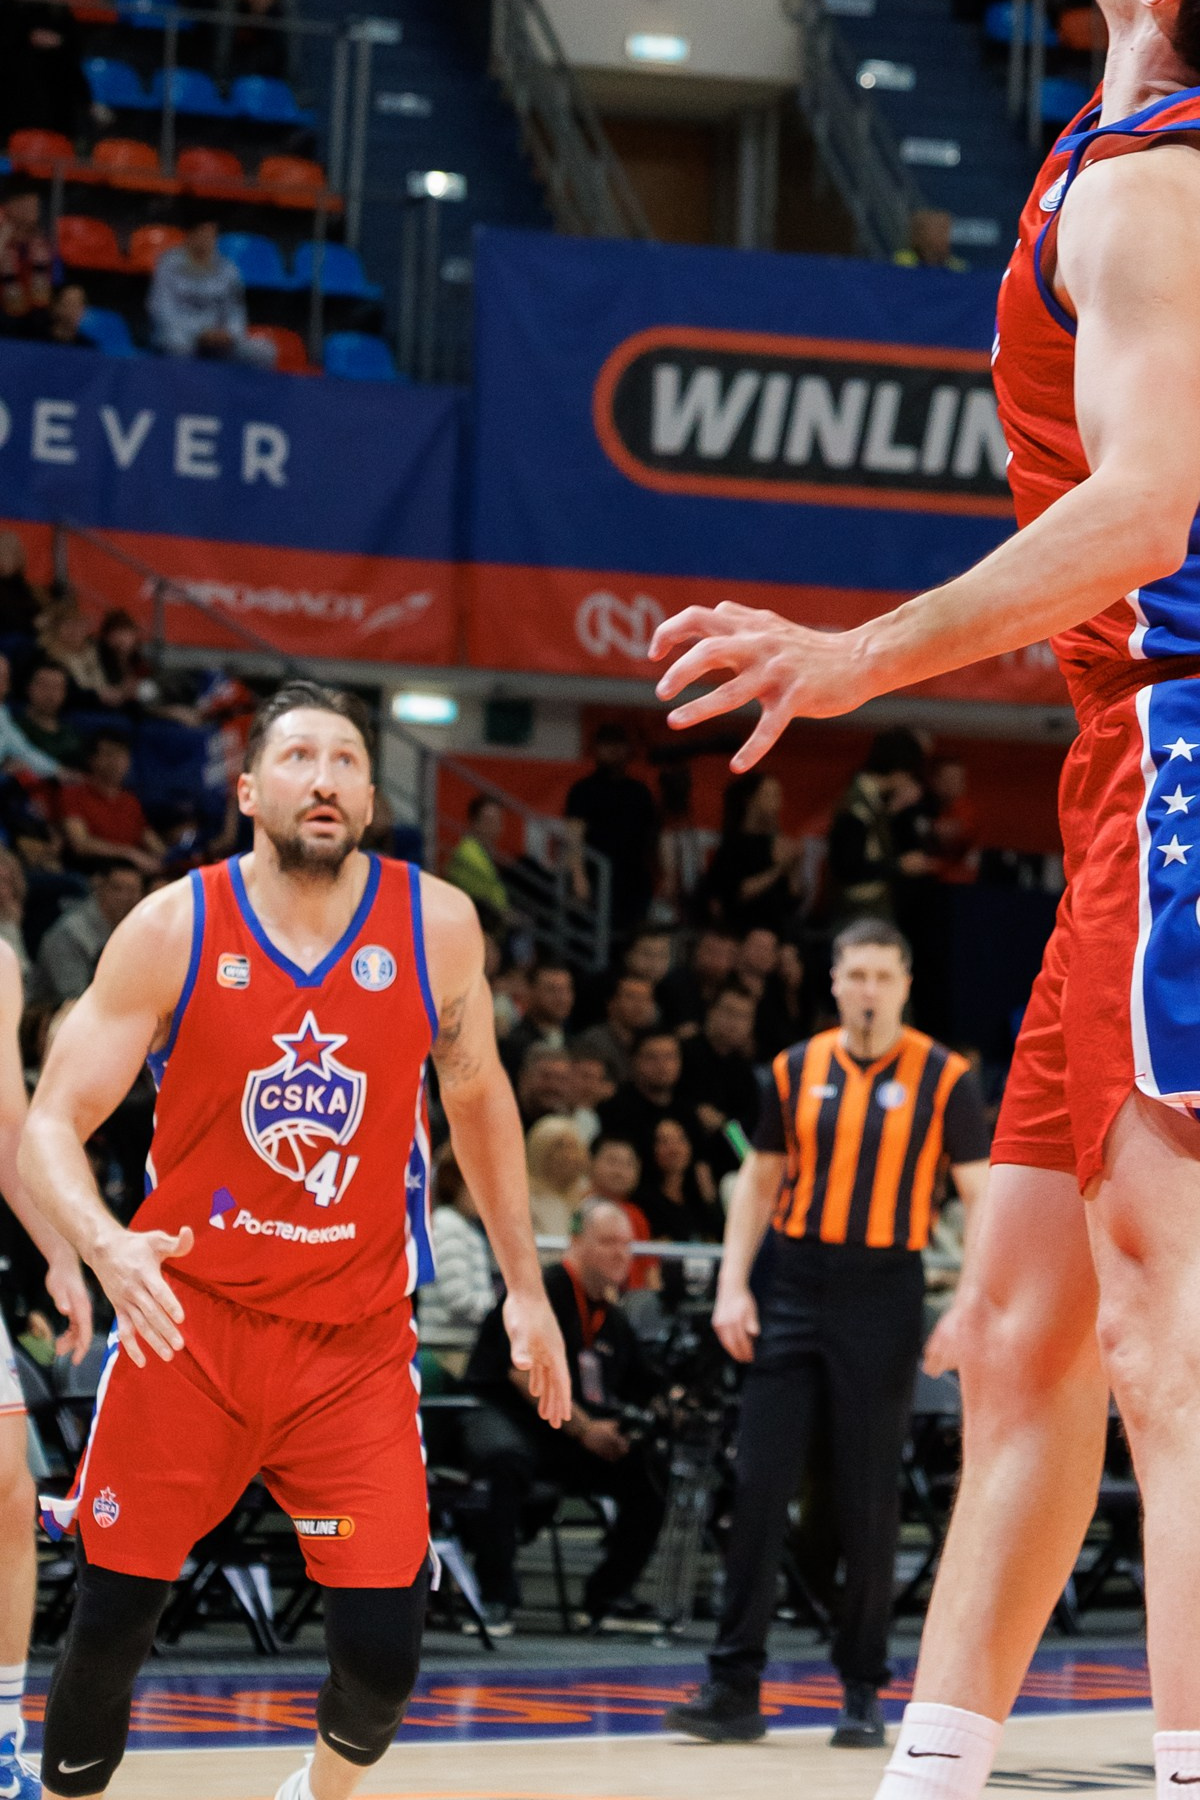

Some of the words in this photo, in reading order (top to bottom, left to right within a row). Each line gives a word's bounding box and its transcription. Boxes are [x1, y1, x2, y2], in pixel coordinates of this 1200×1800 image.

[0, 398, 291, 487] EVER
[260, 1084, 348, 1115] CSKA
[232, 1209, 357, 1244] Ростелеком
